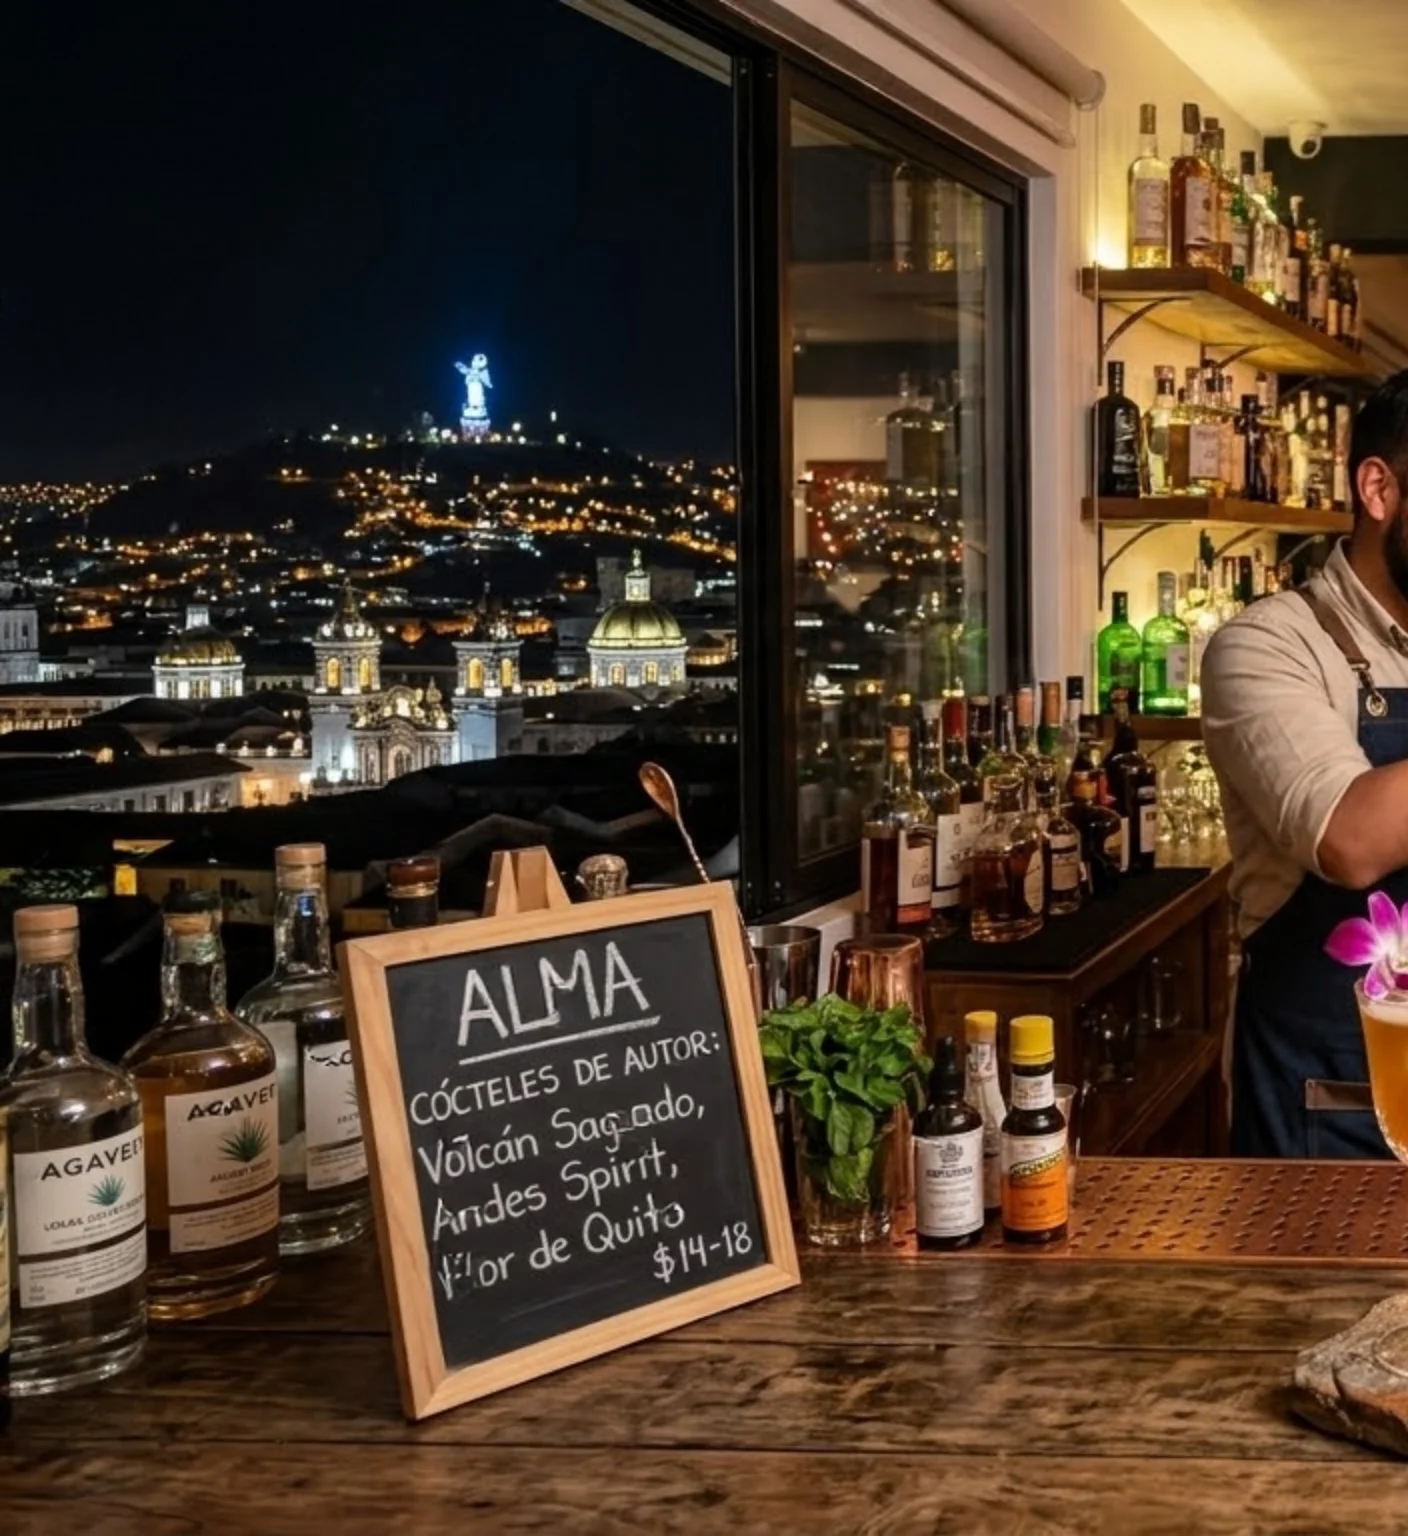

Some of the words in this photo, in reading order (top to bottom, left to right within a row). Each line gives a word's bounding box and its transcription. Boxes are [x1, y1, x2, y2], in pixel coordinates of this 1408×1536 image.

[457, 941, 651, 1046] ALMA
[410, 1065, 560, 1126] CÓCTELES
[573, 1053, 612, 1086] DE
[624, 1030, 720, 1076] AUTOR:
[433, 1182, 547, 1242] Andes
[529, 1229, 571, 1270] de
[583, 1193, 685, 1253] Quito
[653, 1221, 752, 1284] $14-18
